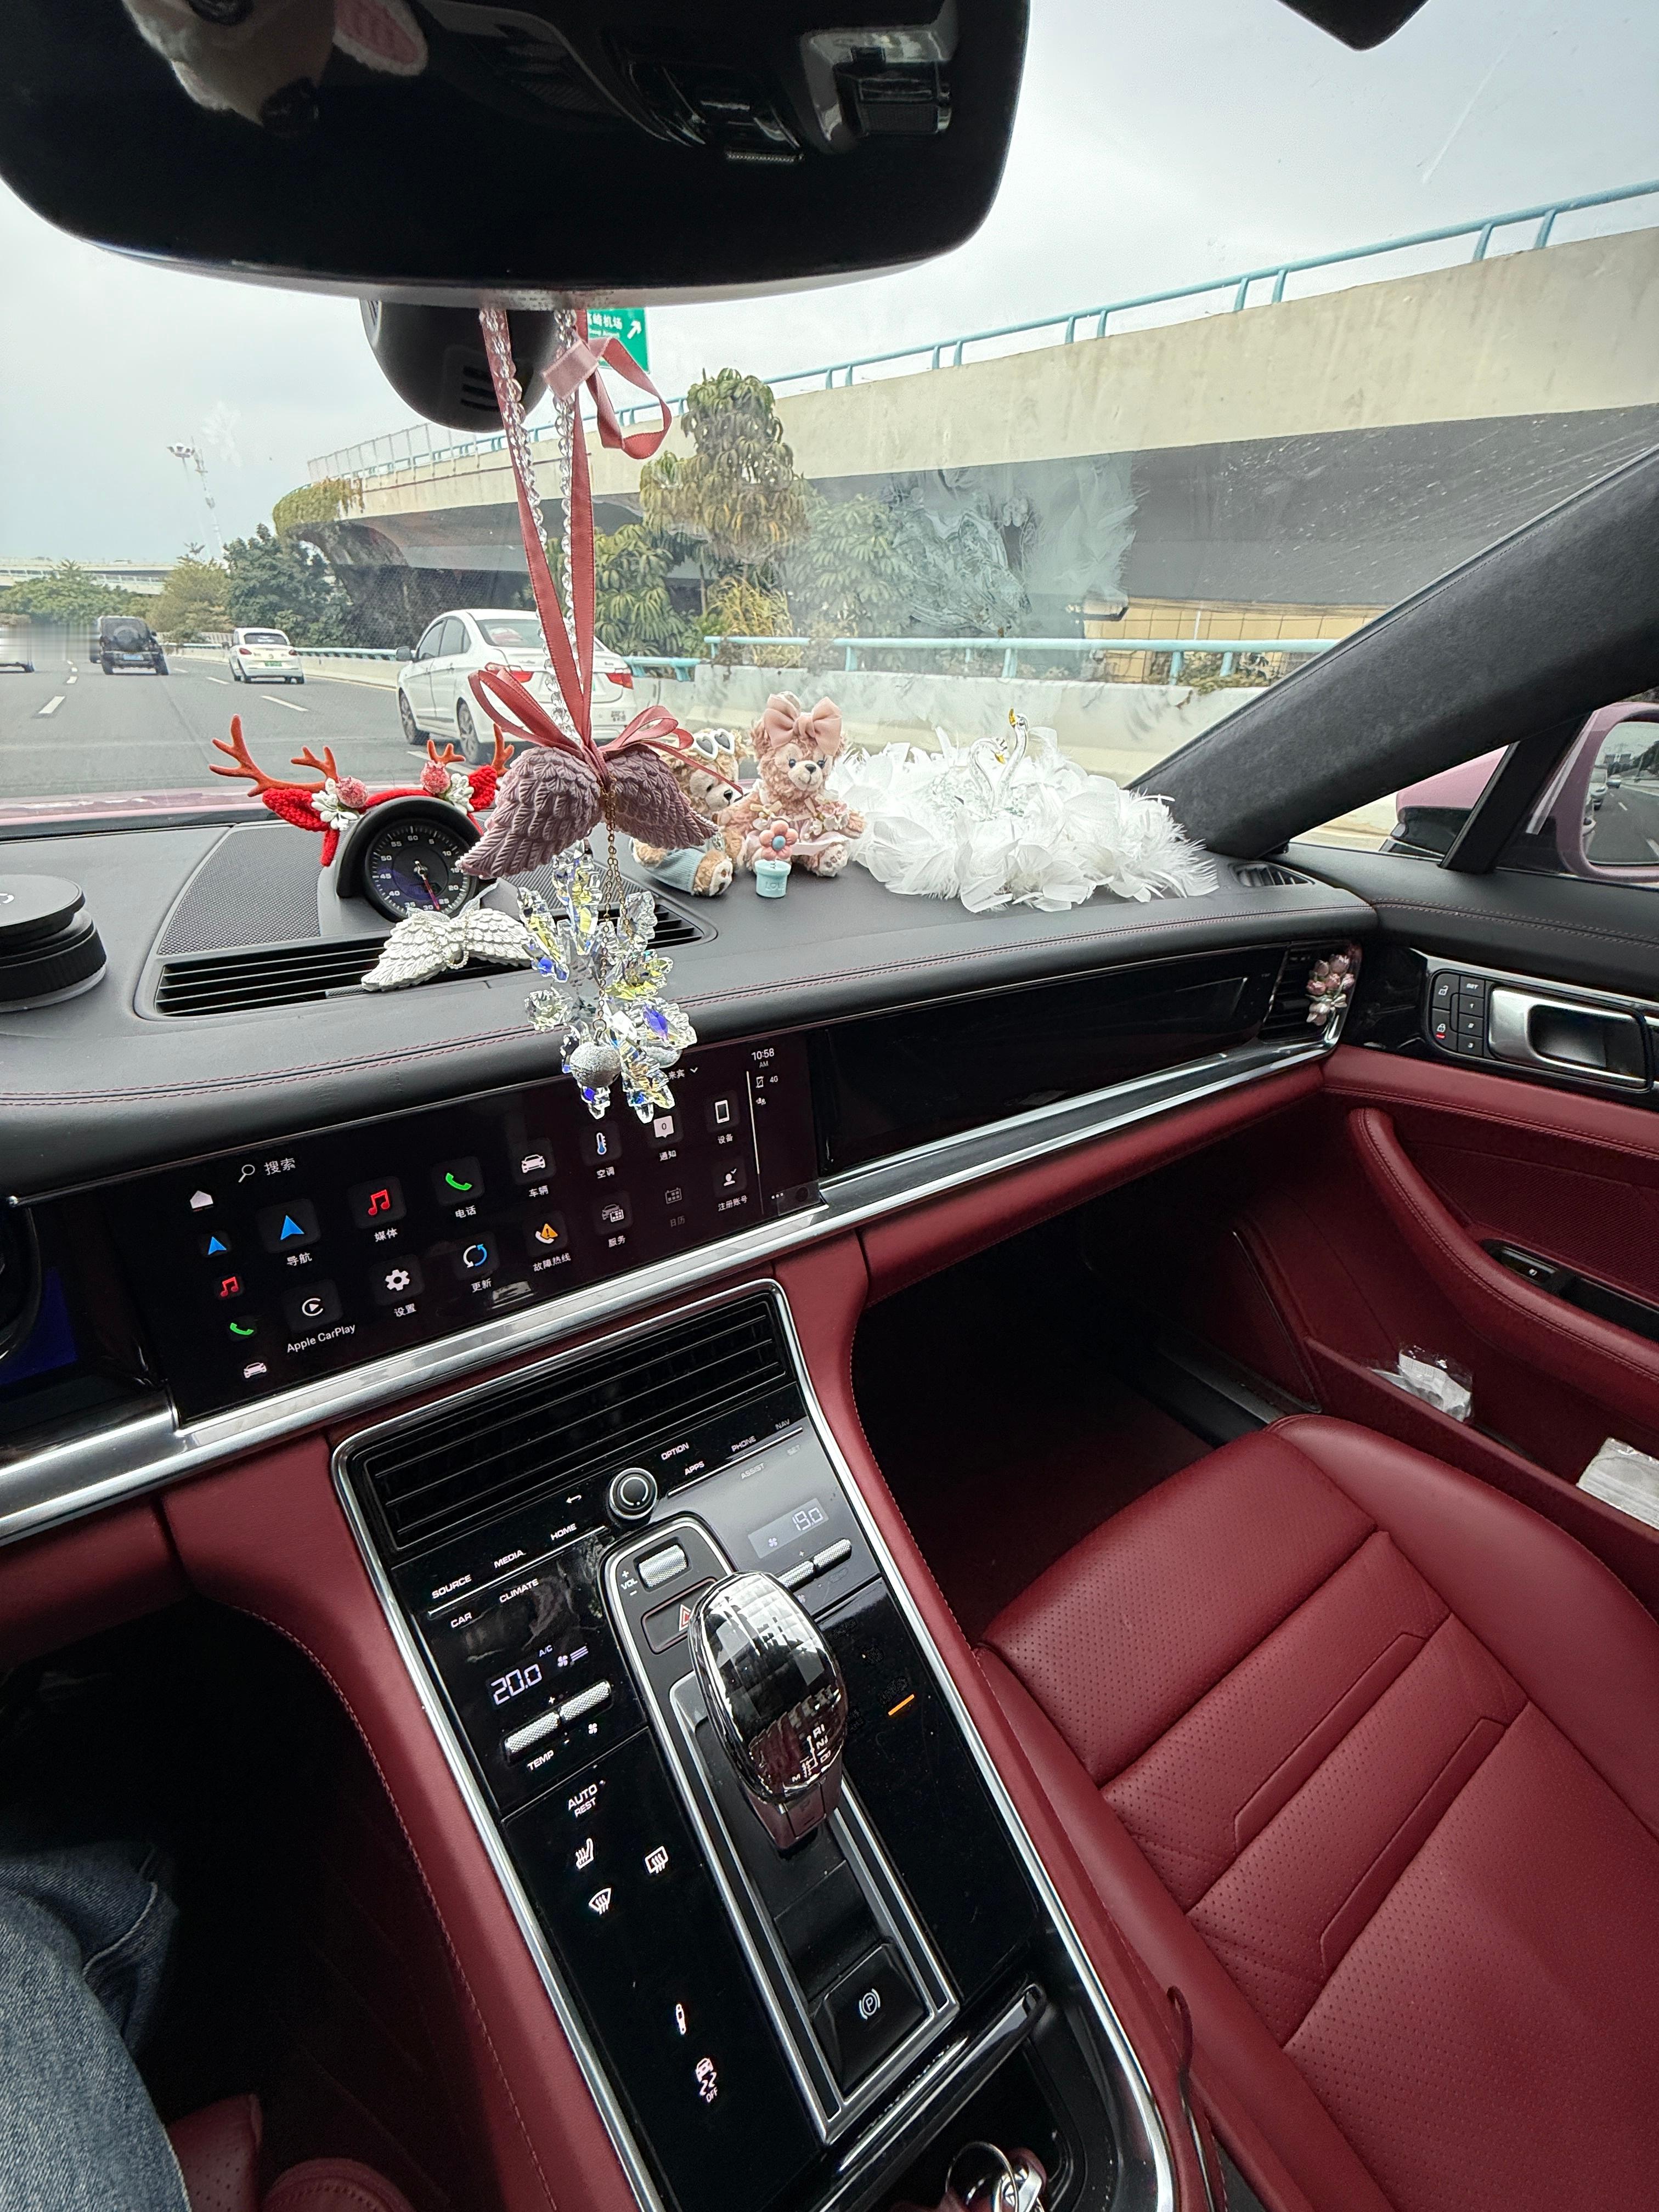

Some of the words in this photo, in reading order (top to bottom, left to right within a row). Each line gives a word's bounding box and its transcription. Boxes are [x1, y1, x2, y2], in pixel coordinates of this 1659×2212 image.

[751, 1048, 775, 1061] 10:58
[668, 1069, 685, 1080] 来宾
[717, 1133, 733, 1146] 设备
[659, 1150, 676, 1162] 通知
[263, 1158, 296, 1176] 搜索
[596, 1166, 615, 1180] 空调
[528, 1185, 549, 1198] 车辆
[718, 1195, 748, 1212] 注册账号
[454, 1205, 477, 1219] 电话
[670, 1215, 685, 1227] 日历
[374, 1228, 398, 1243] 媒体
[608, 1235, 626, 1248] 服务
[286, 1252, 313, 1266] 导航
[533, 1252, 572, 1272] 故障热线
[471, 1278, 492, 1293] 更新
[394, 1303, 417, 1317] 设置
[287, 1337, 317, 1353] Apple
[318, 1324, 356, 1342] CarPlay
[775, 1419, 791, 1430] NAV
[661, 1442, 690, 1461] OPTION
[731, 1435, 757, 1452] PHONE
[787, 1444, 801, 1456] SET
[684, 1461, 705, 1476] APPS
[741, 1463, 765, 1480] ASSIST
[792, 1507, 823, 1531] 19.0
[550, 1523, 577, 1541] HOME
[494, 1549, 524, 1569] MEDIA
[431, 1574, 472, 1600] SOURCE
[499, 1578, 540, 1604] CLIMATE
[620, 1578, 638, 1590] VOL
[450, 1612, 472, 1629] CAR
[539, 1645, 553, 1658] A/C
[490, 1663, 543, 1706] 20.0
[527, 1750, 555, 1771] TEMP
[568, 1783, 597, 1811] AUTO
[573, 1797, 596, 1818] REST
[706, 2086, 718, 2103] OFF
